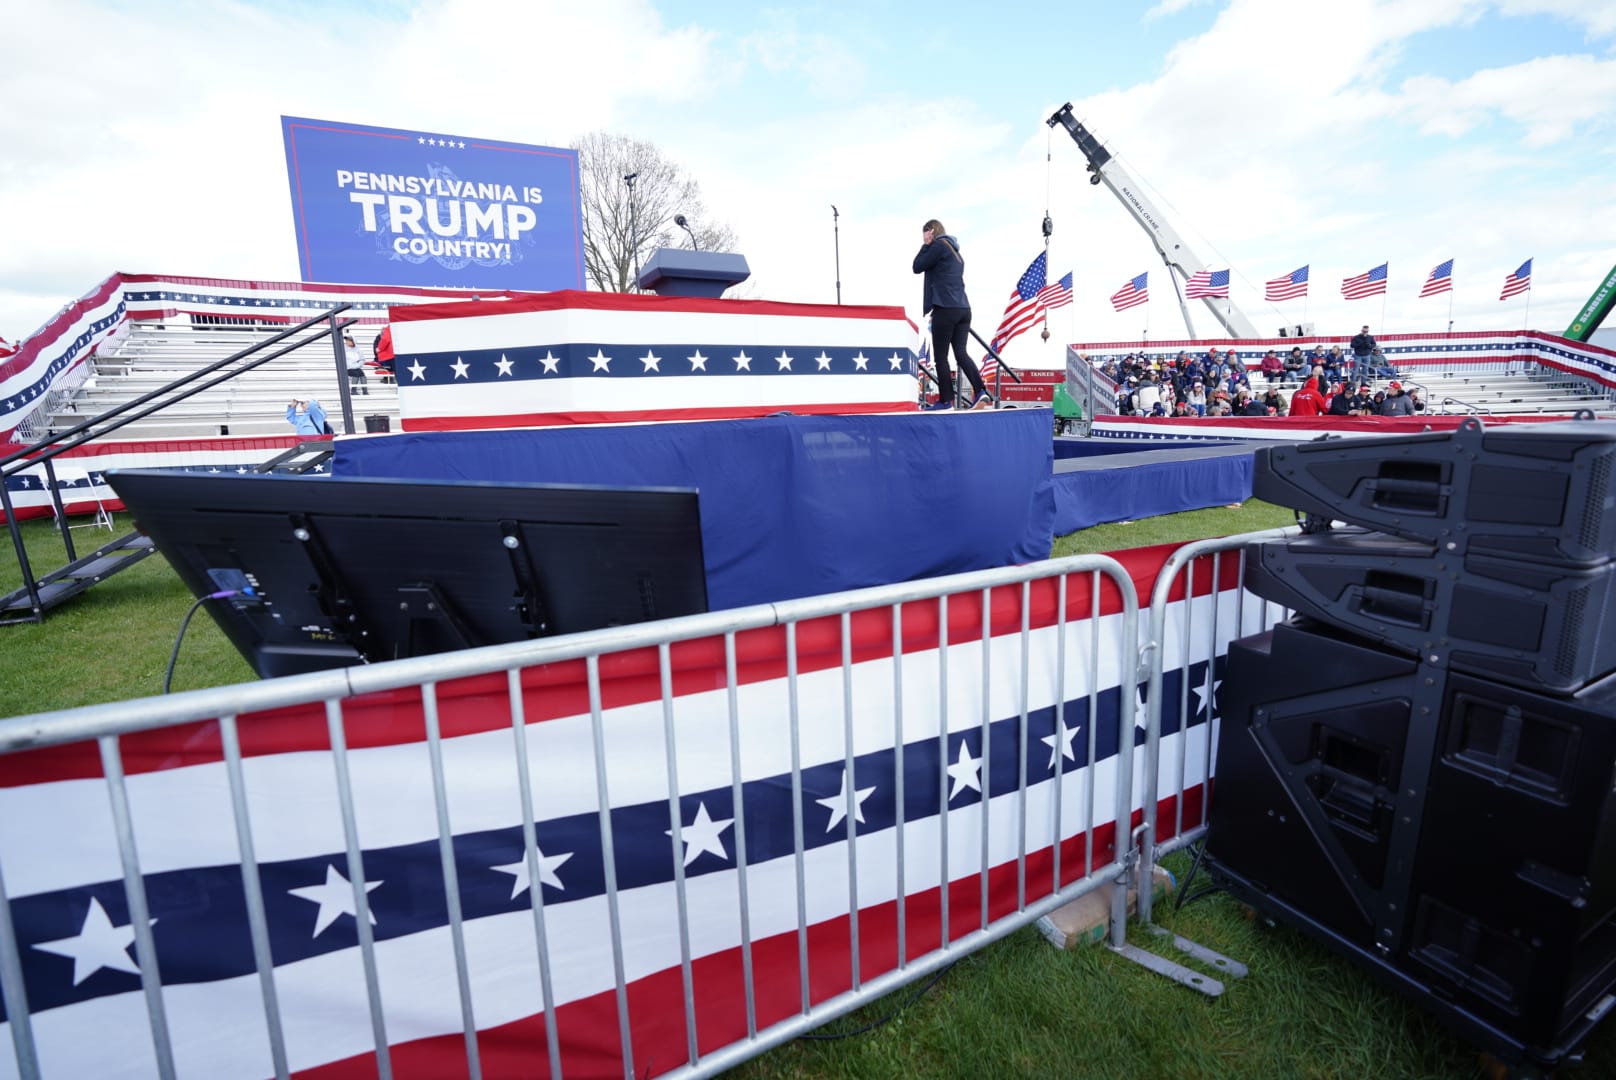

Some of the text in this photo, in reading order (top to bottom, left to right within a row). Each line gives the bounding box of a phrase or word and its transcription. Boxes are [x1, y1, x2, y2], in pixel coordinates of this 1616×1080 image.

[336, 169, 543, 204] PENNSYLVANIA IS
[349, 191, 537, 241] TRUMP
[1122, 187, 1159, 230] NATIONAL CRANE
[393, 237, 511, 260] COUNTRY!
